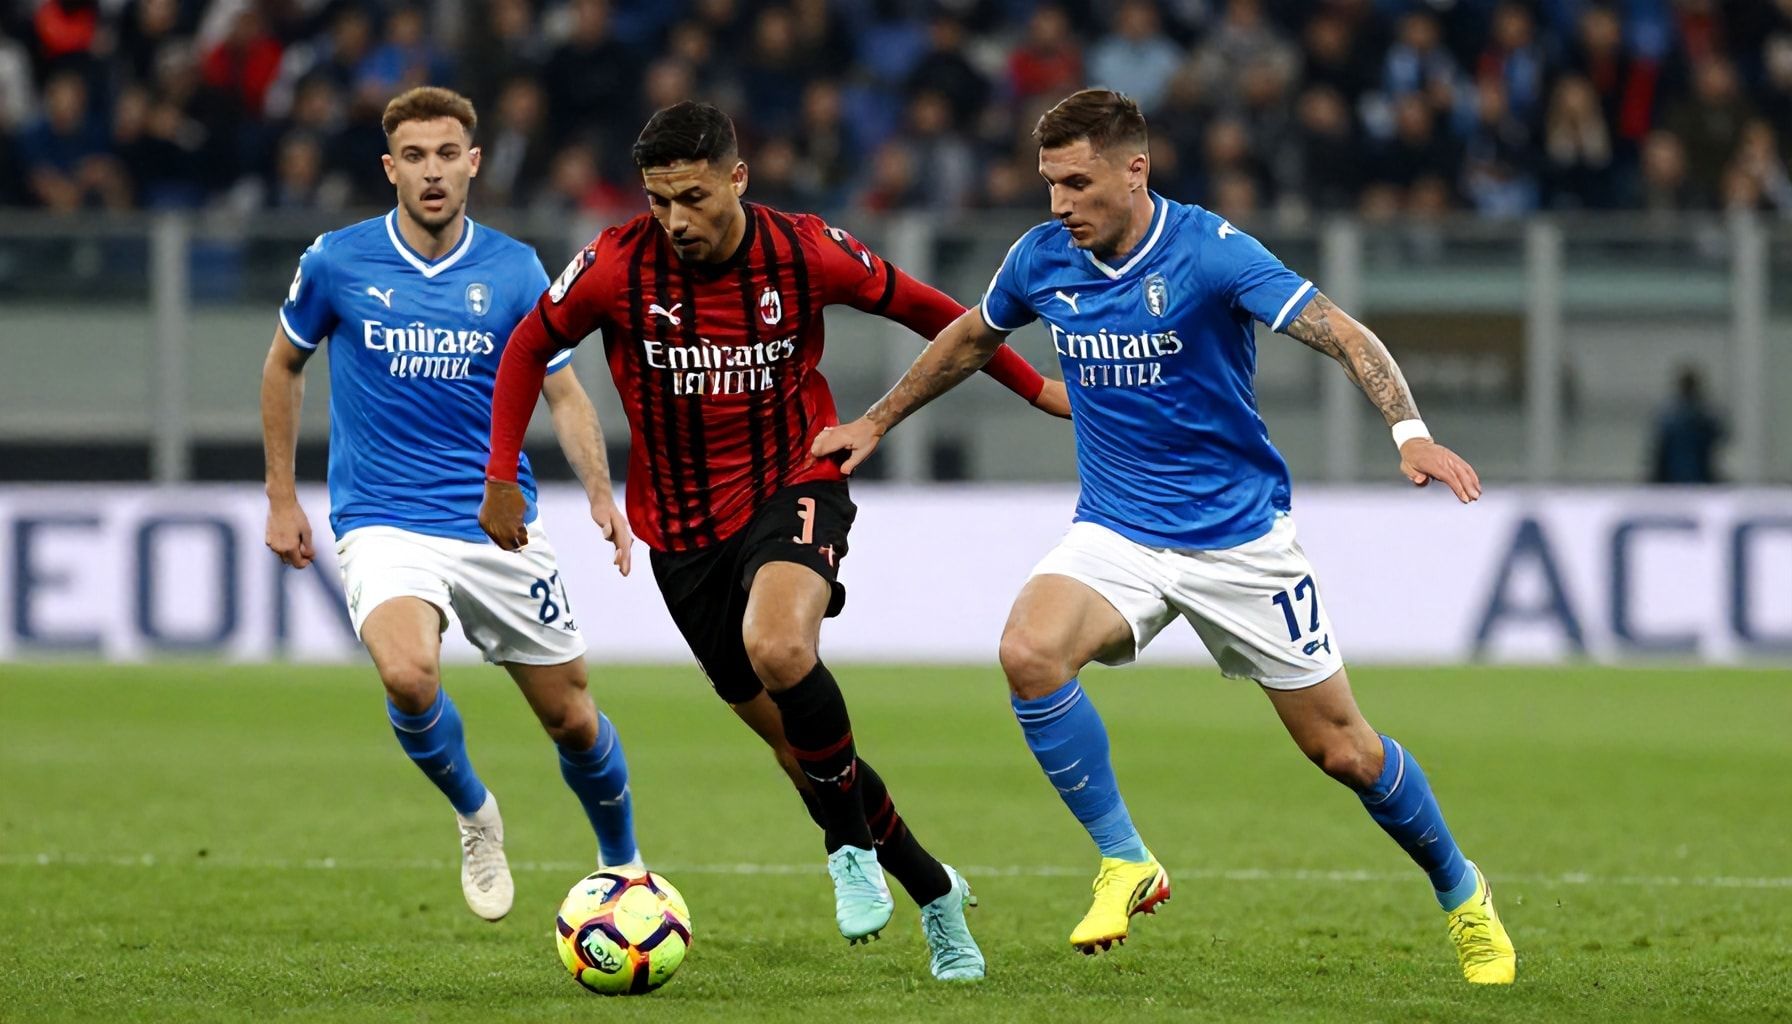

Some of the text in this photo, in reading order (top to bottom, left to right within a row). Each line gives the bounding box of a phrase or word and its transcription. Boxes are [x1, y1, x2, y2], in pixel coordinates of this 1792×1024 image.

[362, 319, 495, 355] Emirates
[643, 335, 797, 369] Emirates
[1050, 324, 1183, 359] Emirates
